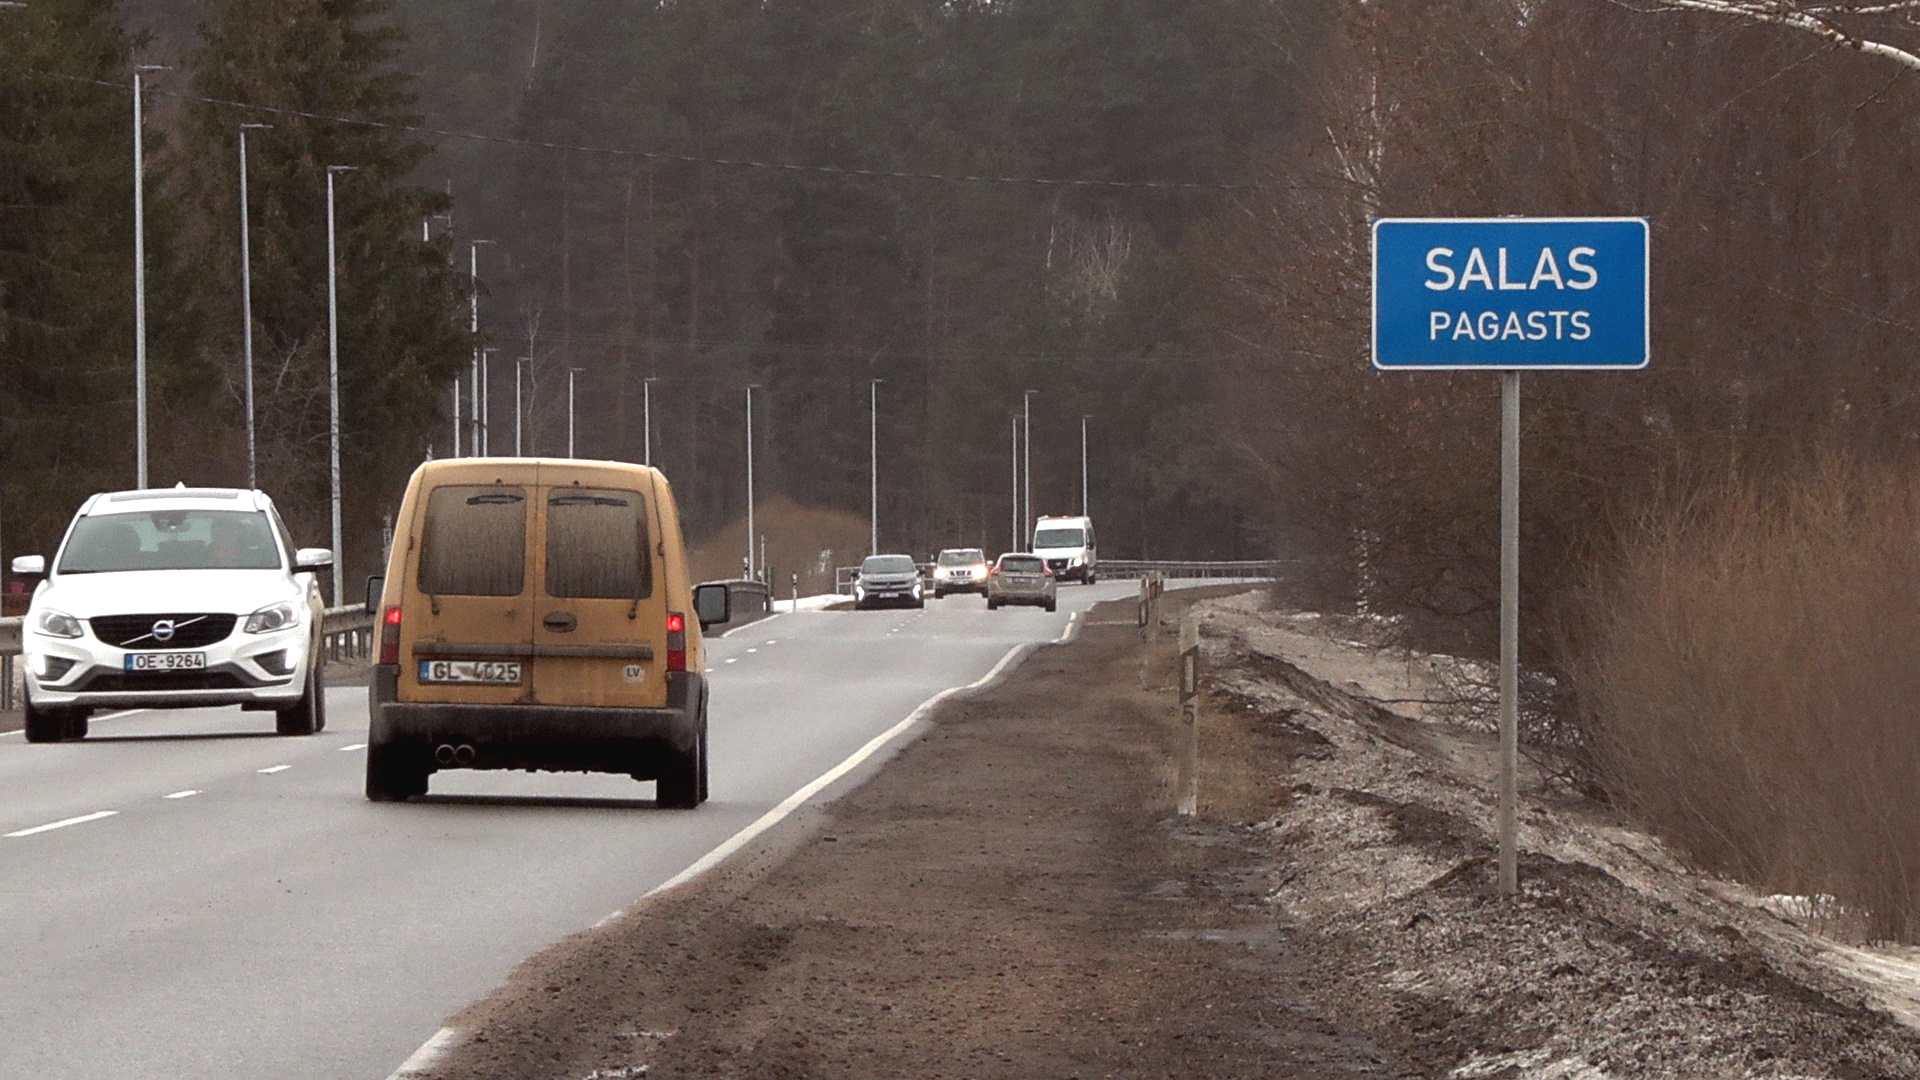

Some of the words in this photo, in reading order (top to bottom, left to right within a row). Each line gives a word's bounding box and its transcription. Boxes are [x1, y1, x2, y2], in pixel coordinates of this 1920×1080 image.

[1425, 247, 1598, 291] SALAS
[1430, 311, 1592, 340] PAGASTS
[136, 655, 202, 669] OE-9264
[627, 667, 640, 677] LV
[1183, 705, 1194, 725] 5
